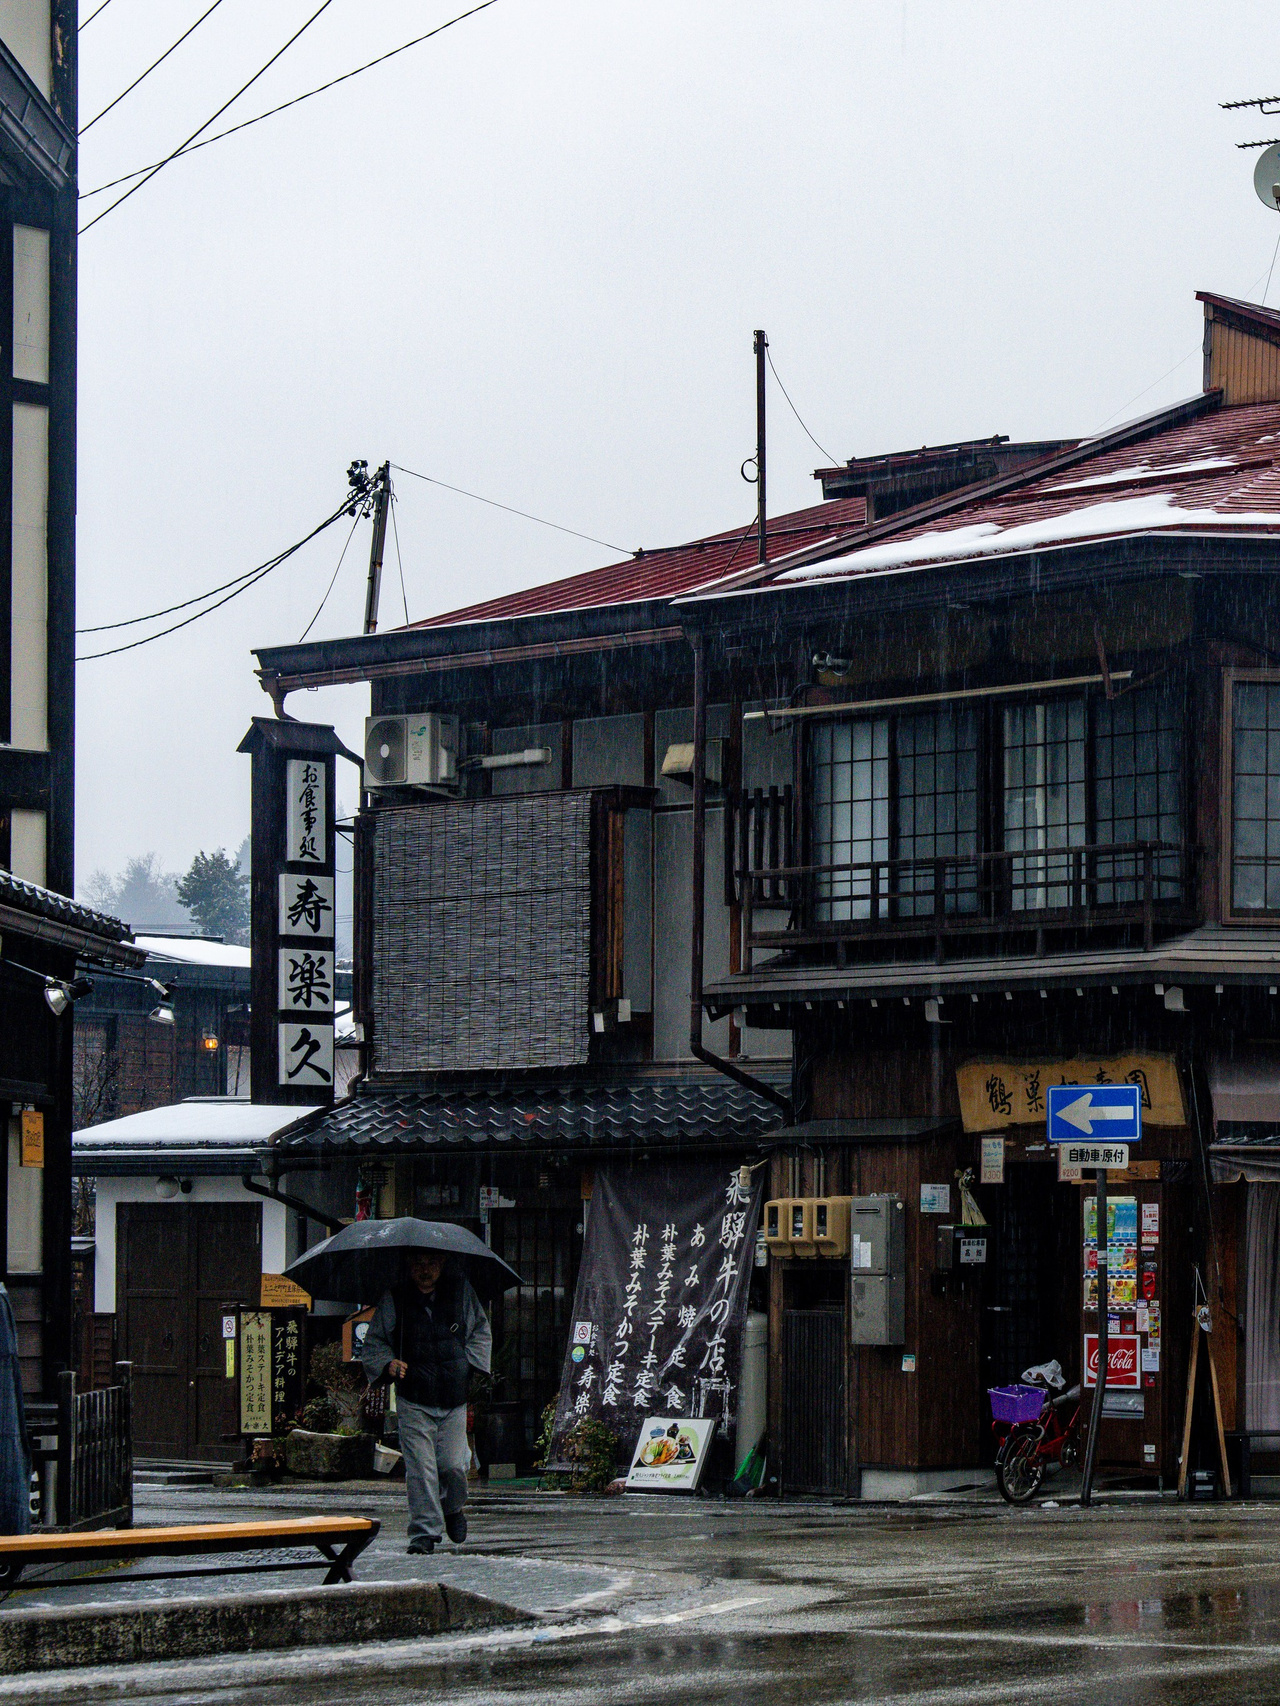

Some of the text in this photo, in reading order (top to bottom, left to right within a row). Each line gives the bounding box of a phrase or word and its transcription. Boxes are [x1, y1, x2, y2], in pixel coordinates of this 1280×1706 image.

[298, 763, 321, 861] お食事処
[287, 878, 332, 1083] 寿楽久
[985, 1068, 1152, 1116] 鶴巣園
[285, 1319, 299, 1376] 飛騨牛の
[601, 1224, 650, 1407] 朴葉みそかつ定食
[631, 1223, 679, 1408] 朴葉みそステーキ定食
[663, 1223, 705, 1410] あみ焼定食
[246, 1333, 255, 1413] 朴葉みそかつ定食
[257, 1333, 266, 1413] 朴葉ステーキ定食
[274, 1326, 286, 1403] アイデア料理
[574, 1365, 597, 1427] 寿楽
[1089, 1348, 1136, 1370] Coa-Cola
